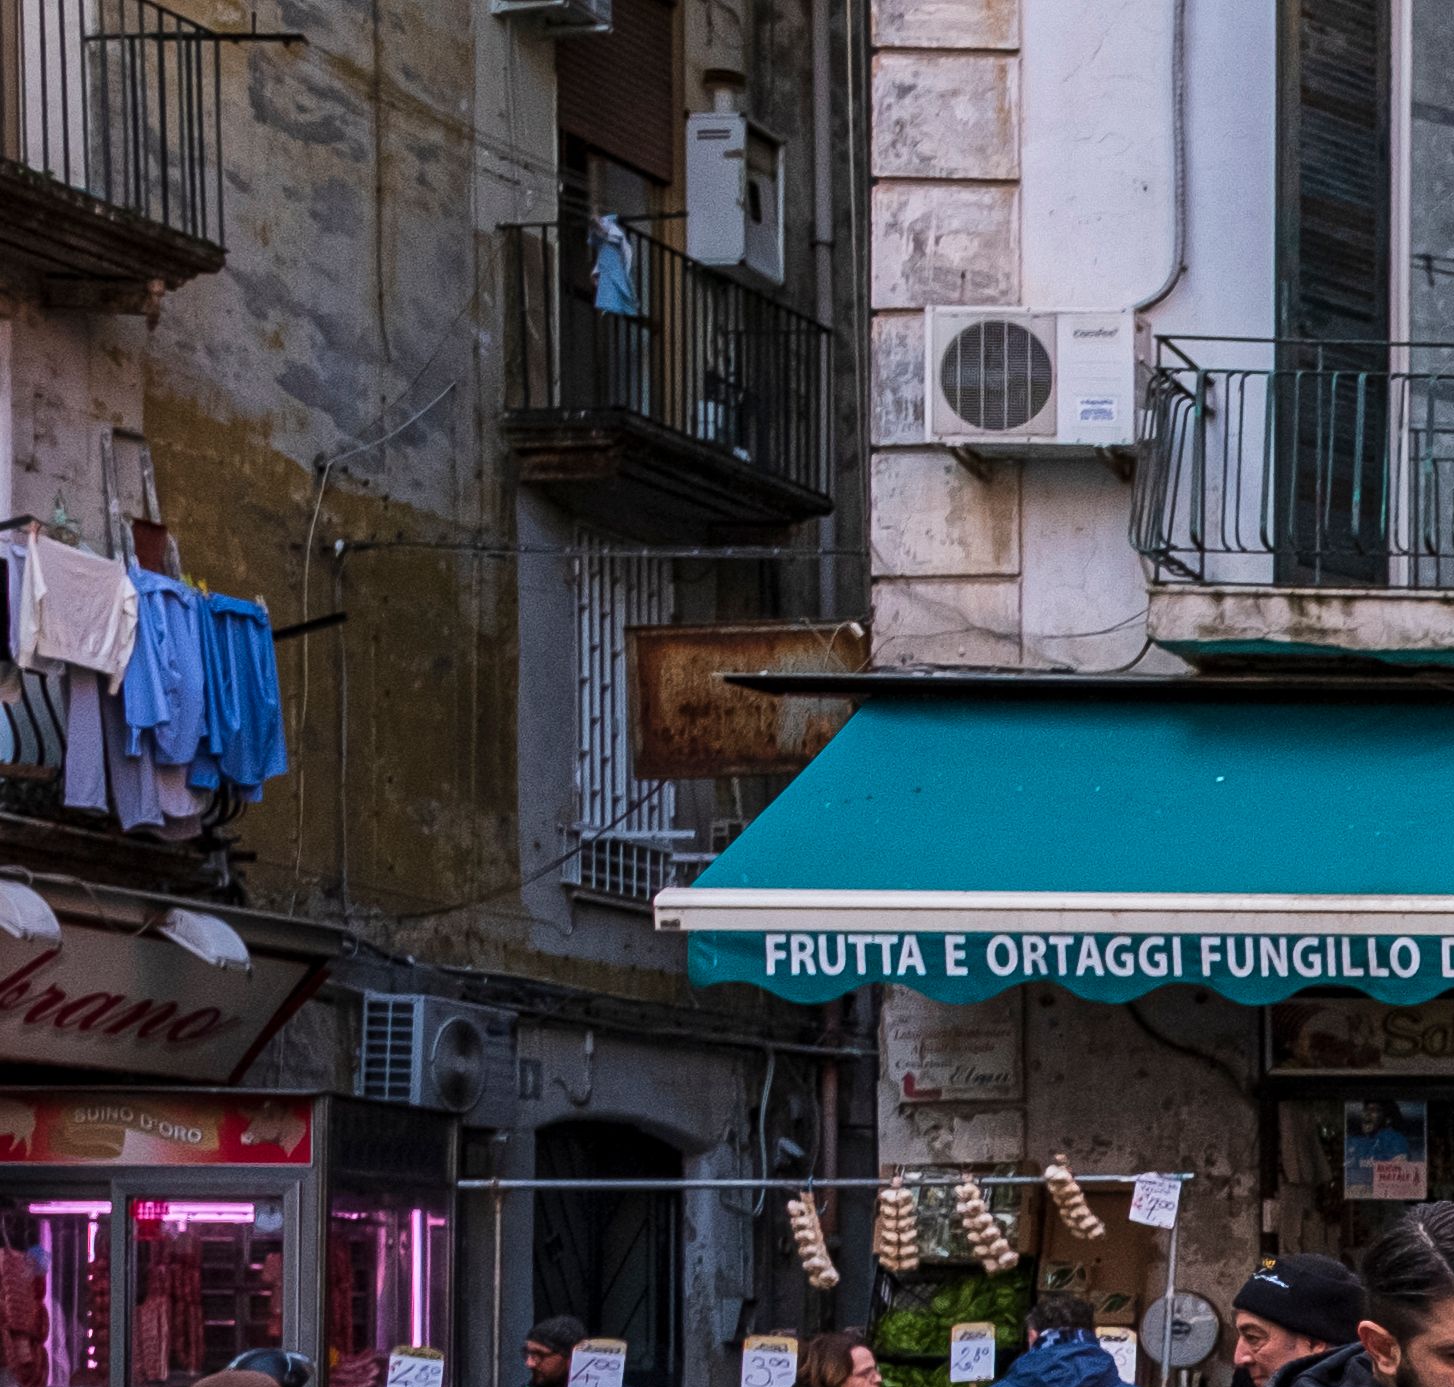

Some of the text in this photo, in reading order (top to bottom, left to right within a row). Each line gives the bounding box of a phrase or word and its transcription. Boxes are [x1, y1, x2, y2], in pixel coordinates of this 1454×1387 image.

[765, 935, 925, 975] FRUTTA
[945, 936, 967, 975] E
[986, 936, 1182, 976] ORTAGGI
[1201, 937, 1421, 978] FUNGILLO
